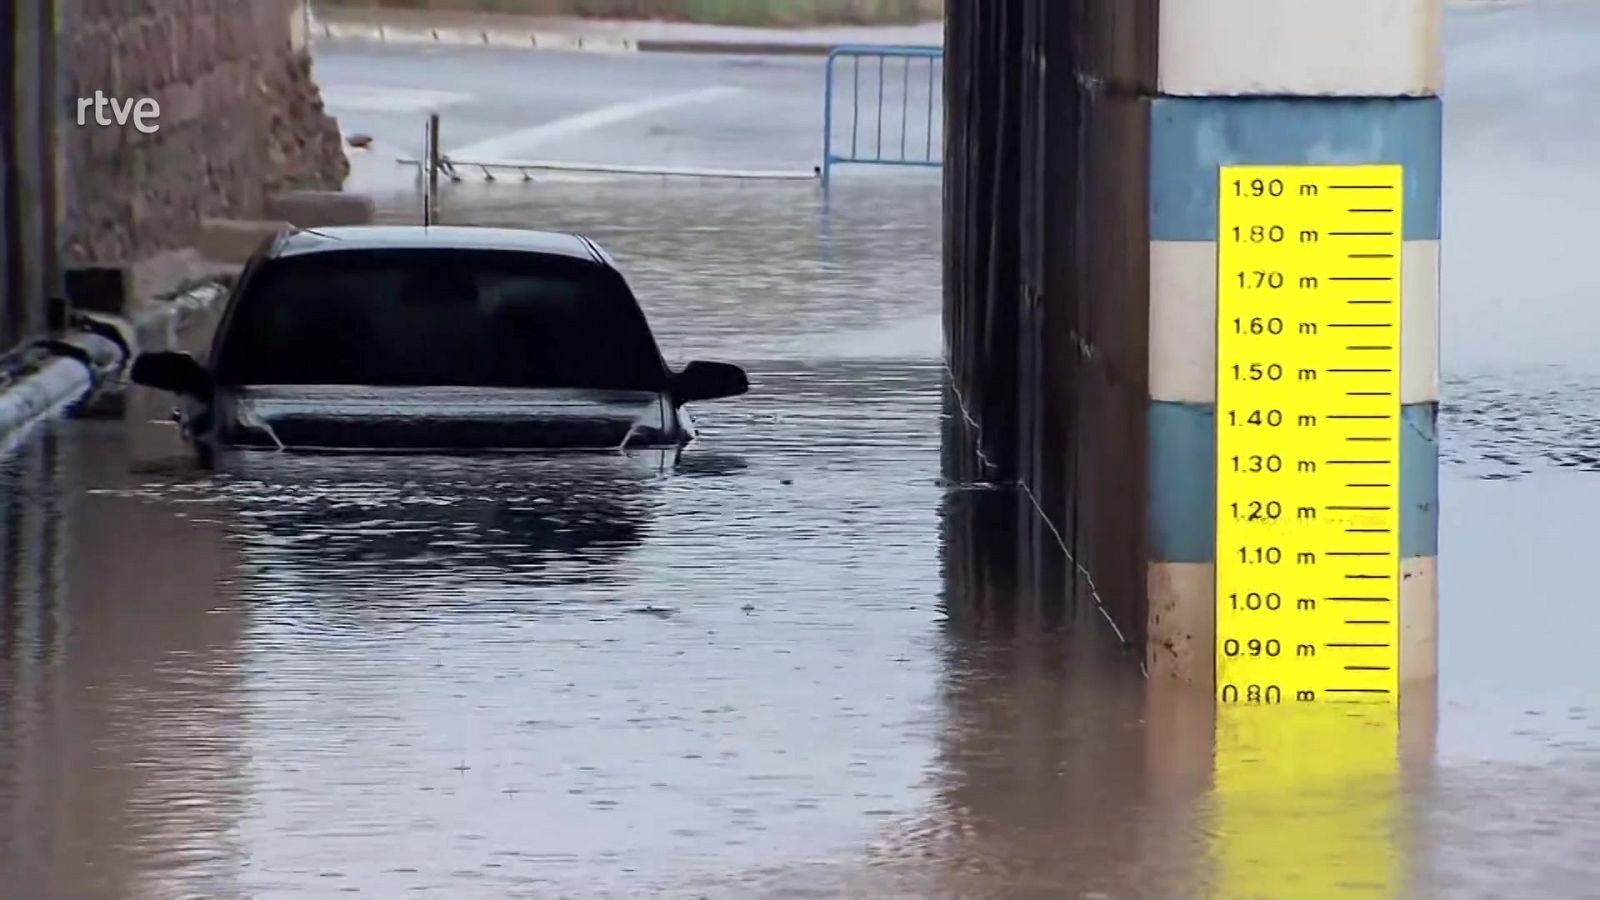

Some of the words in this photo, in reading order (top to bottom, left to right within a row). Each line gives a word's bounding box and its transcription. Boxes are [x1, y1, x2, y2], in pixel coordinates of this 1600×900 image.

[1233, 179, 1284, 197] 1.90
[1300, 183, 1318, 196] m
[1232, 225, 1284, 243] 1.80
[1300, 229, 1319, 243] m
[1237, 271, 1284, 289] 1.70
[1299, 276, 1318, 289] m
[1233, 317, 1283, 335] 1.60
[1299, 322, 1317, 335] m
[1232, 363, 1282, 381] 1.50
[1298, 368, 1317, 381] m
[1228, 410, 1282, 427] 1.40
[1298, 414, 1316, 427] m
[1231, 455, 1282, 473] 1.30
[1297, 460, 1316, 473] m
[1230, 501, 1281, 520] 1.20
[1297, 506, 1316, 519] m
[1239, 547, 1281, 564] 1.10
[1297, 552, 1315, 565] m
[1229, 592, 1281, 611] 1.00
[1297, 598, 1315, 611] m
[1224, 639, 1281, 657] 0.90
[1296, 644, 1315, 657] m
[1296, 690, 1315, 703] m
